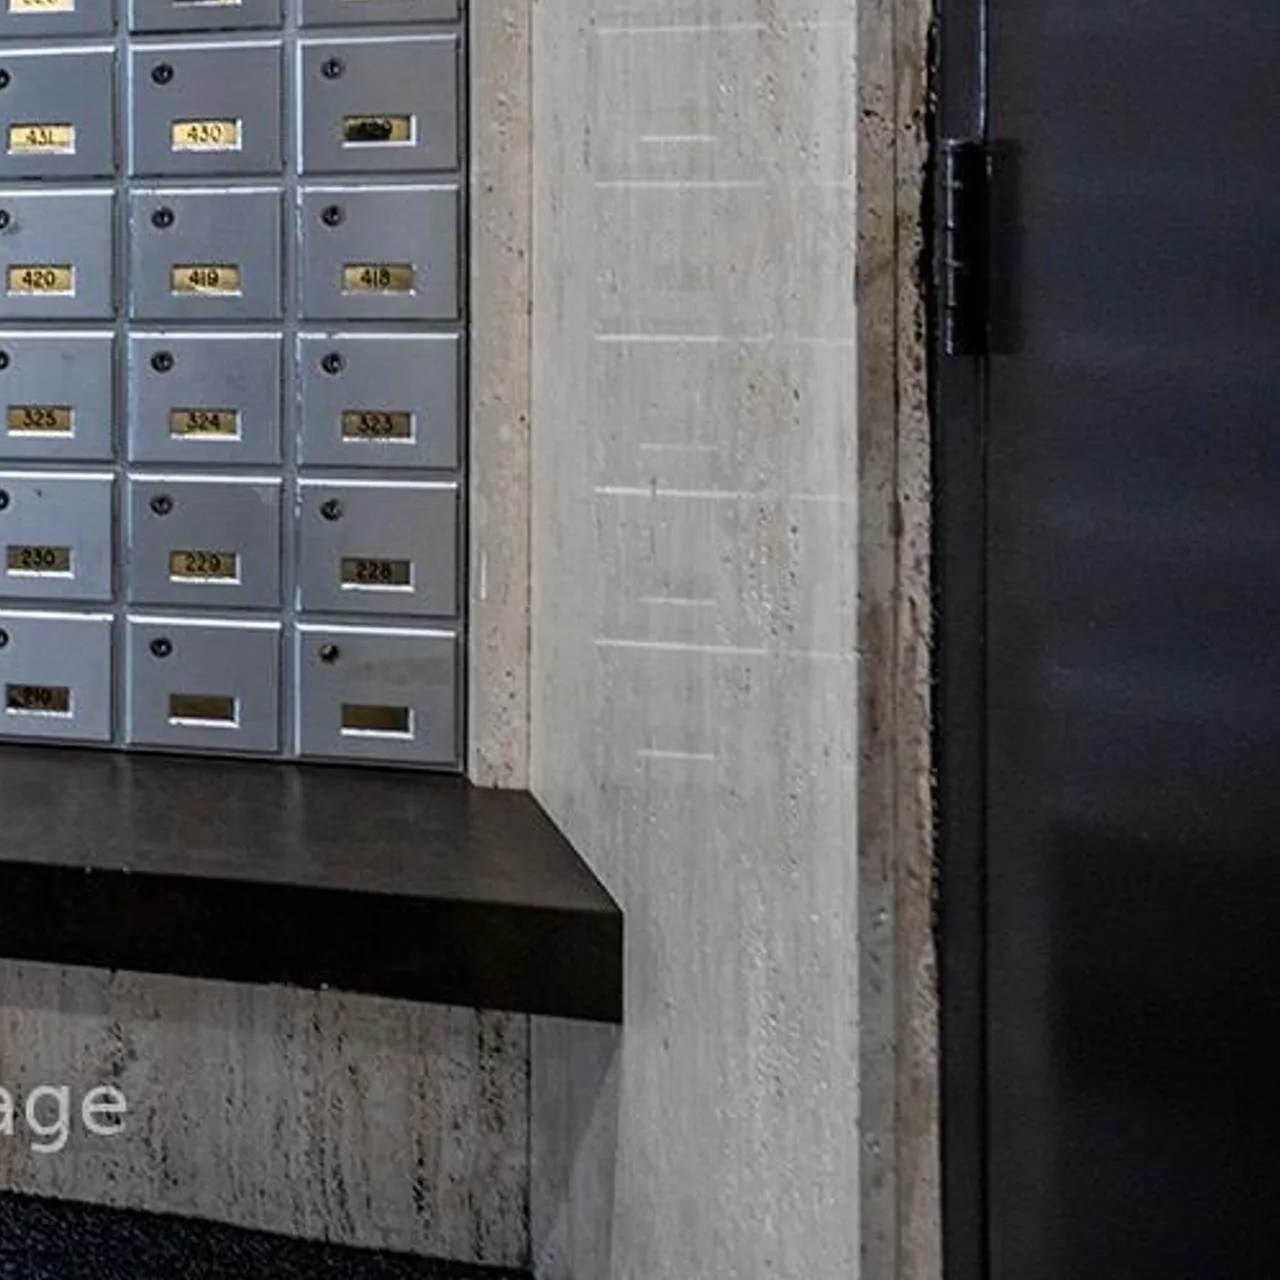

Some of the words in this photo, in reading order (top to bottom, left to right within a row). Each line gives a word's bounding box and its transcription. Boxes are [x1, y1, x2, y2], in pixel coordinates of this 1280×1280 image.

[26, 130, 54, 145] 431
[188, 126, 221, 142] 430
[23, 271, 55, 289] 420
[190, 270, 218, 286] 419
[361, 269, 390, 287] 418
[23, 409, 56, 427] 325
[187, 412, 219, 432] 324
[358, 413, 393, 434] 323
[21, 549, 55, 566] 230
[186, 553, 220, 573] 229
[356, 562, 391, 581] 228
